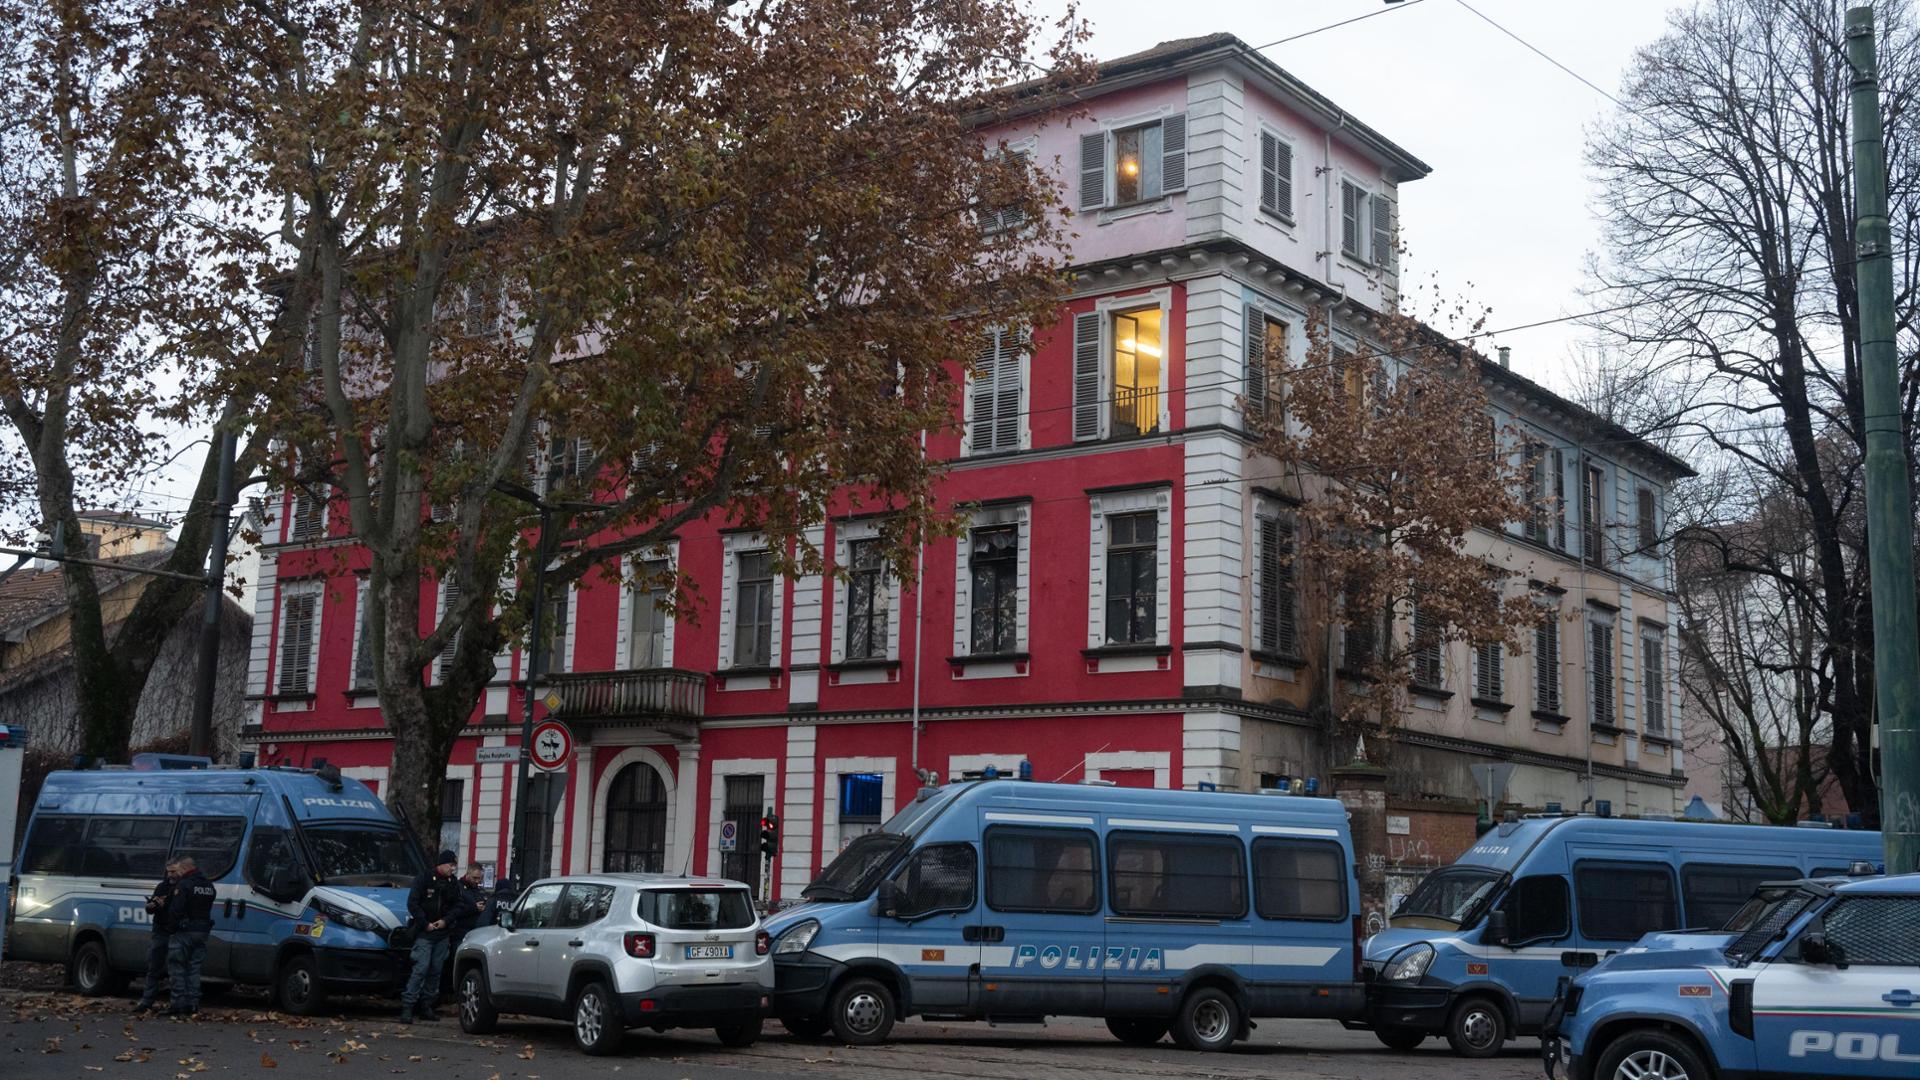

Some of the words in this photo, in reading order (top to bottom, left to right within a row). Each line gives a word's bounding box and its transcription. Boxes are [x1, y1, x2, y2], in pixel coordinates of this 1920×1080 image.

[303, 798, 376, 810] POLIZIA
[496, 900, 514, 912] POLI
[1014, 944, 1161, 971] POLIZIA
